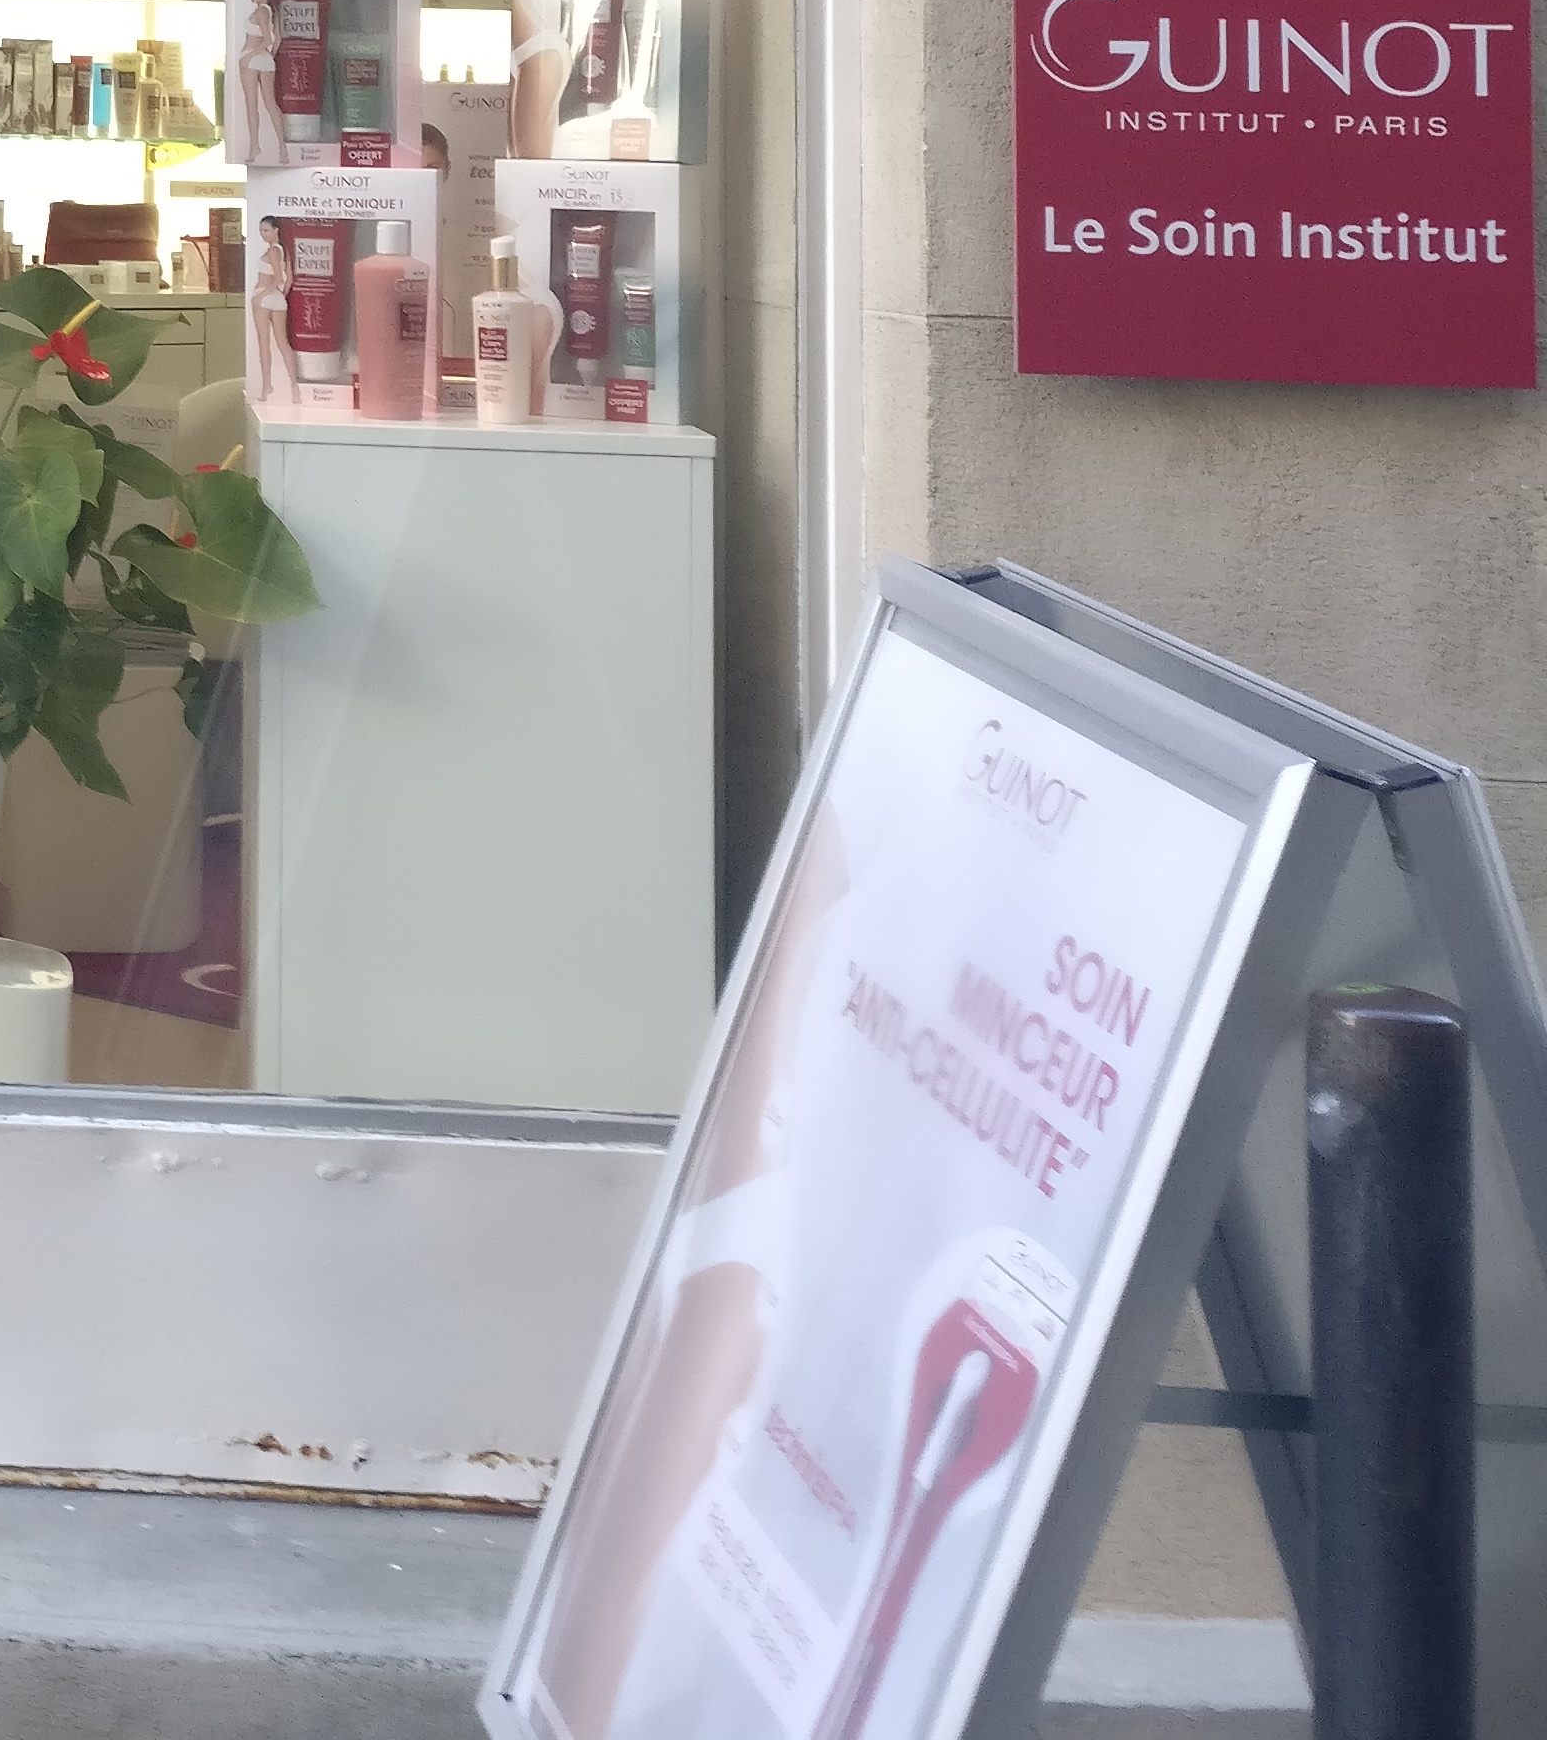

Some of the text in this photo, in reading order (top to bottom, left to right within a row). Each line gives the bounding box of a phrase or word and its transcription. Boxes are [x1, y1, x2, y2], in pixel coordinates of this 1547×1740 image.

[449, 92, 507, 110] GUINO
[1104, 109, 1450, 138] INSTITUT PARIS
[309, 171, 373, 188] GUINOT
[278, 195, 319, 208] FERME
[336, 197, 397, 210] TONIQUE
[1043, 206, 1509, 264] Le Soin Institut
[964, 719, 1088, 838] GUINOT
[1043, 934, 1153, 1049] SOIN
